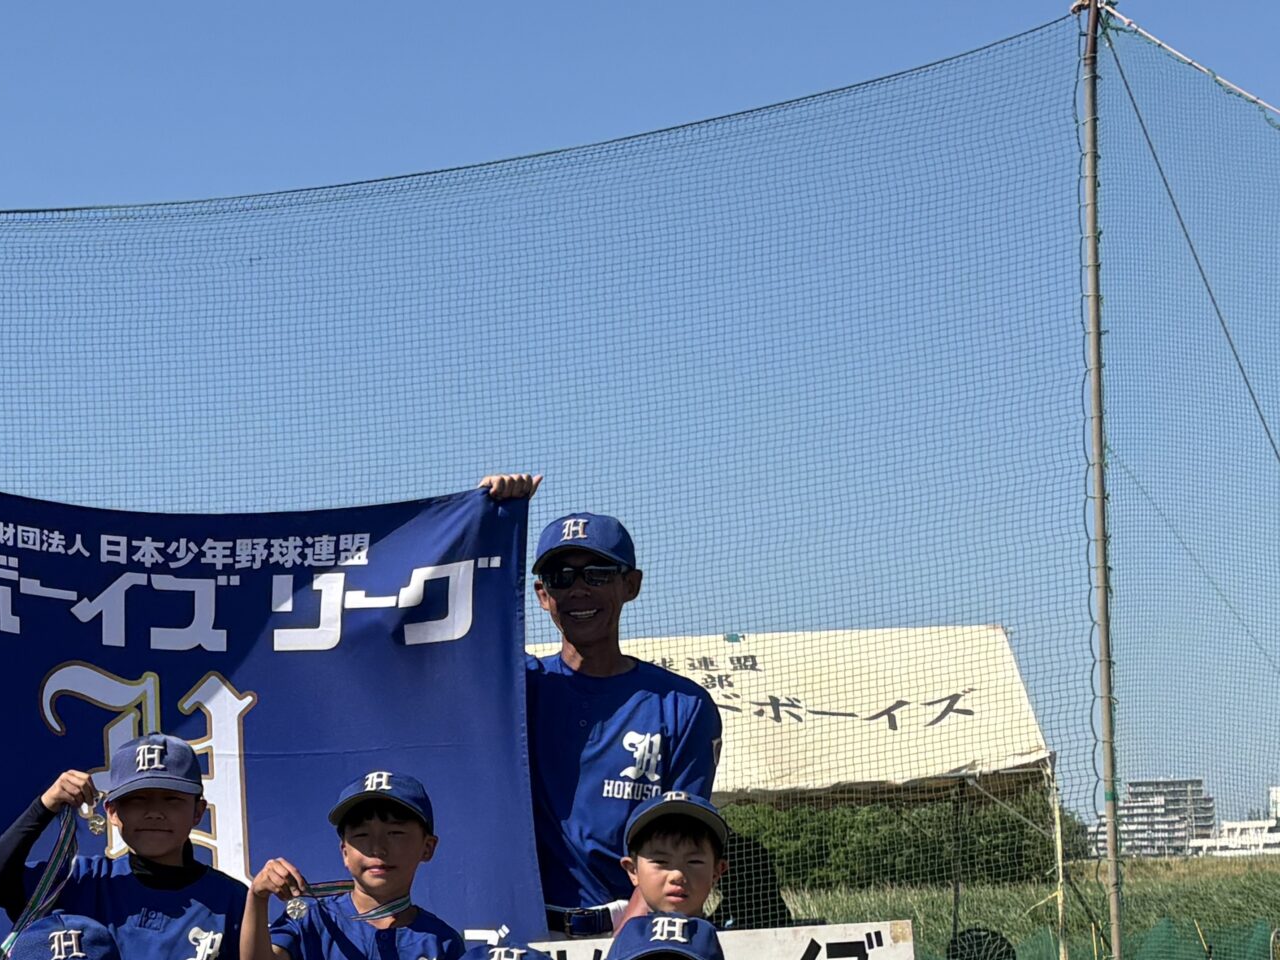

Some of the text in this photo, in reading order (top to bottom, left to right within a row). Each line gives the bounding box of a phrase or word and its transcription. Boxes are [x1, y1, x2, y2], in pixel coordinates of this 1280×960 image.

[559, 518, 589, 541] H
[99, 533, 370, 570] 日本少年野球連盟
[272, 556, 501, 652] リーグ
[135, 743, 167, 773] H
[364, 771, 393, 791] H
[649, 916, 689, 943] H
